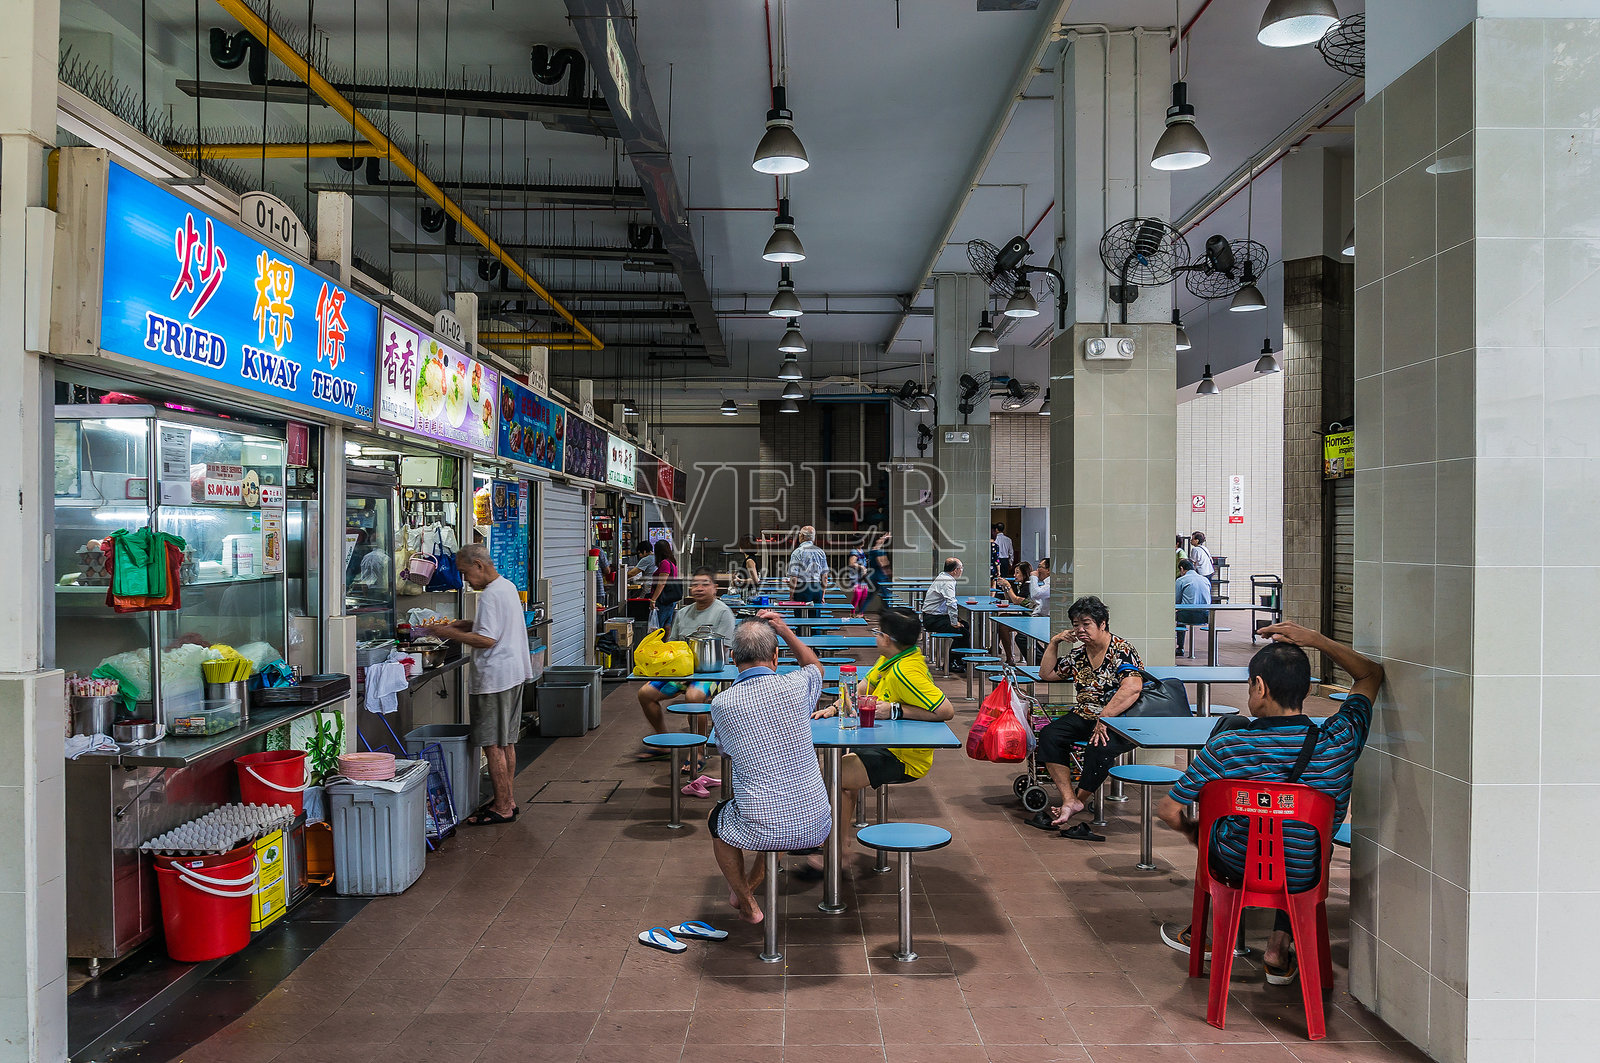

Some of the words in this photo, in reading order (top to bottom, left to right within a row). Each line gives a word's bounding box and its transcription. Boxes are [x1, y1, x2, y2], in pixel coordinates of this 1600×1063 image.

[255, 199, 299, 248] 01-01
[440, 314, 461, 341] 01-02
[144, 310, 227, 369] FRIED
[242, 345, 302, 391] KWAY
[311, 371, 357, 408] TEOW
[384, 331, 415, 398] 香香
[1326, 436, 1350, 447] Homes
[1235, 790, 1251, 806] 星
[1277, 793, 1295, 809] 標
